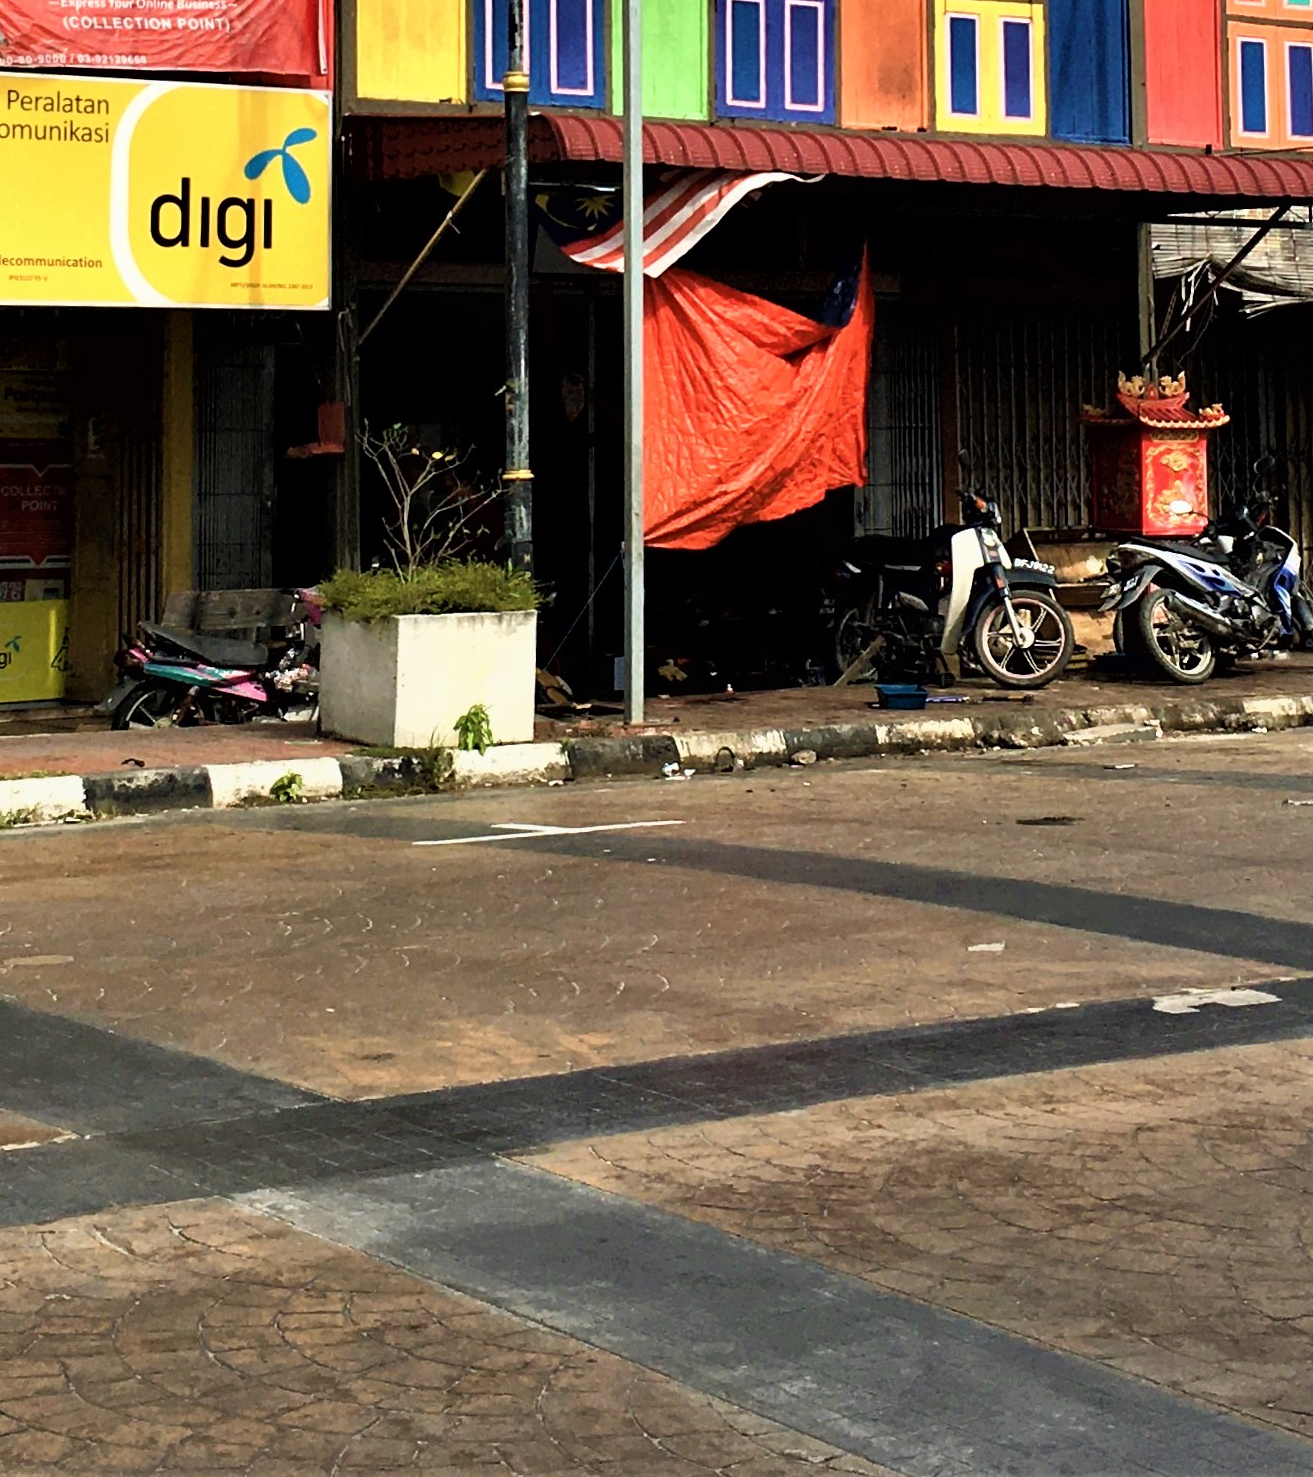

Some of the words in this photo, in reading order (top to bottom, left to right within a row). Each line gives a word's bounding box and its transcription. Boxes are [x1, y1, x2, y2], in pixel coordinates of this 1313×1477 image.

[63, 16, 172, 31] (COLLECTION
[177, 17, 230, 33] POINT)
[7, 89, 110, 115] Peralatan
[150, 177, 273, 268] digi
